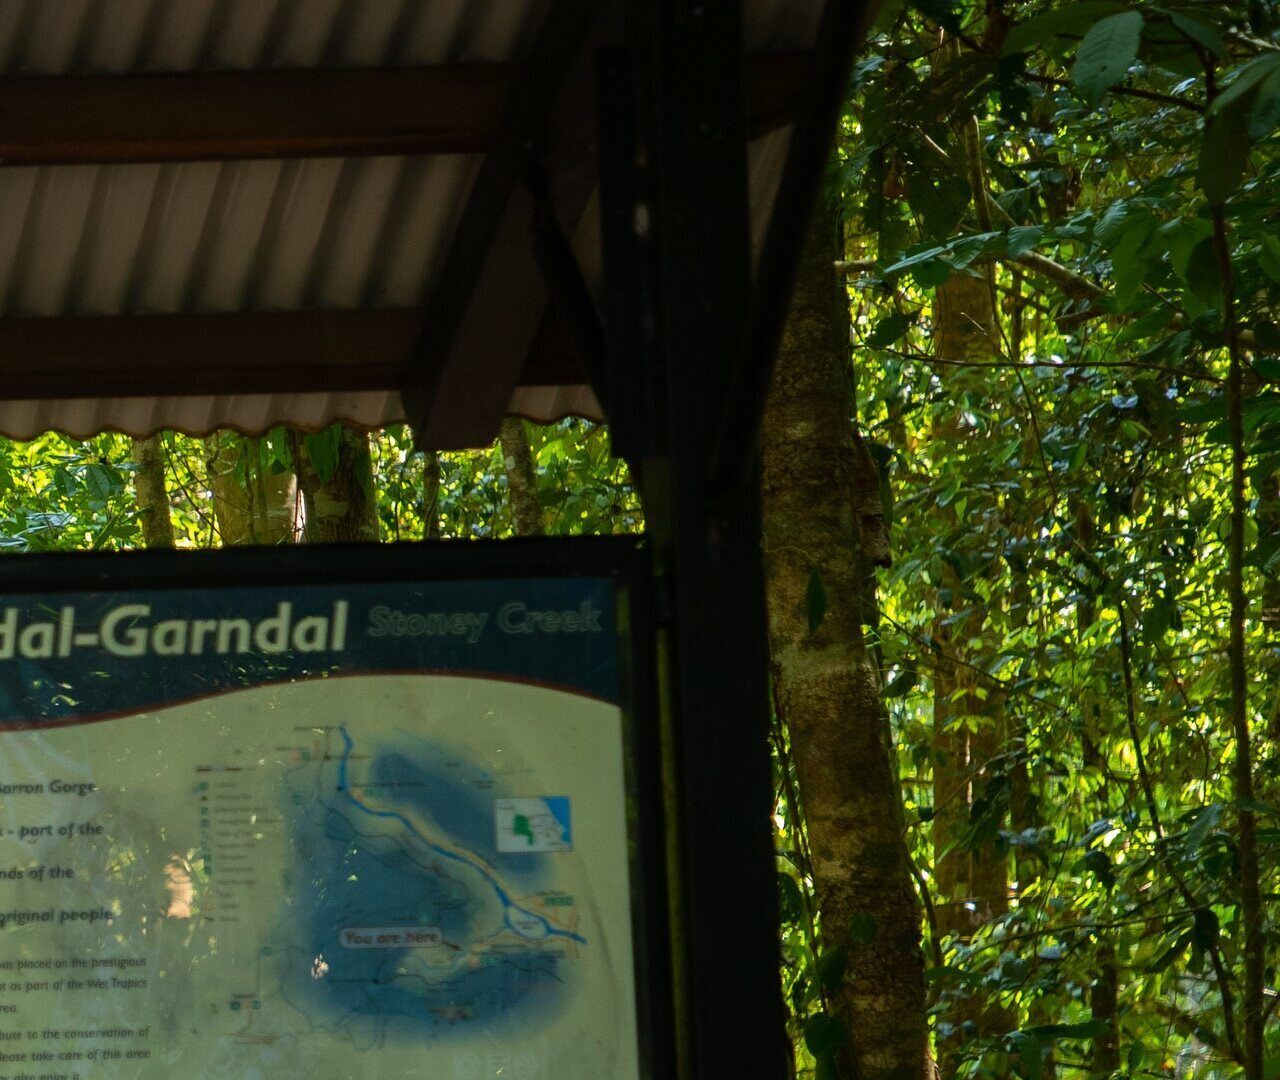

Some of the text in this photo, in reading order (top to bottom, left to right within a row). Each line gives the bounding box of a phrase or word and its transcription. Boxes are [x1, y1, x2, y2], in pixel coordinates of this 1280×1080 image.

[368, 605, 487, 641] Stoney
[500, 600, 603, 635] Creek
[49, 780, 96, 798] Gorge
[19, 825, 53, 841] part
[58, 823, 76, 839] of
[78, 822, 105, 835] the
[27, 866, 47, 882] of
[49, 866, 74, 879] the
[346, 930, 440, 944] You are here
[17, 958, 52, 972] placed
[54, 960, 69, 968] on
[71, 957, 89, 968] the
[91, 956, 147, 971] prestigious
[9, 983, 23, 991] as
[25, 980, 49, 994] part
[52, 979, 65, 992] of
[67, 978, 84, 990] the
[87, 978, 109, 989] Wet
[110, 977, 149, 992] Tropics
[27, 1030, 39, 1039] to
[42, 1028, 60, 1039] the
[63, 1027, 135, 1038] conservation
[137, 1026, 152, 1039] of
[31, 1050, 55, 1061] take
[58, 1052, 83, 1060] care
[87, 1049, 100, 1062] of
[102, 1048, 122, 1059] this
[125, 1051, 151, 1059] area
